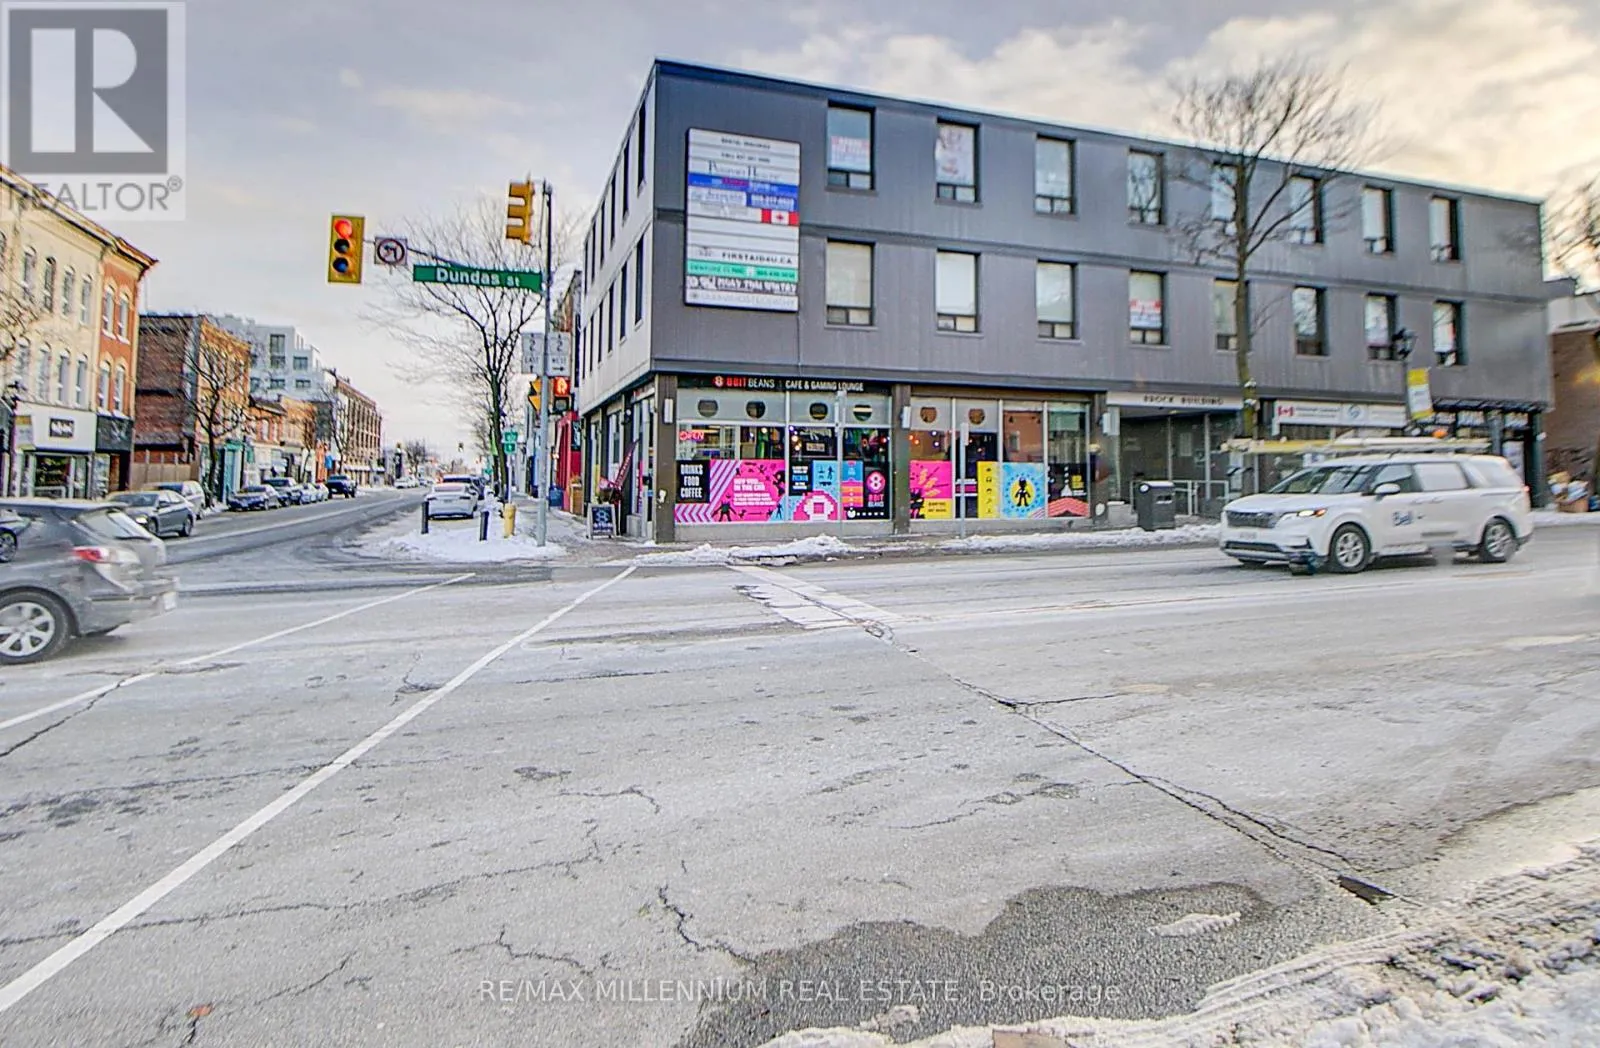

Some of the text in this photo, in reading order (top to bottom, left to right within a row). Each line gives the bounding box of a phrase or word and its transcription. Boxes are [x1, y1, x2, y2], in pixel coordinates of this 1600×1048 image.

[436, 267, 501, 286] Dundas
[748, 378, 775, 389] BEANS
[811, 381, 837, 391] GAMING
[838, 382, 864, 392] LOUNGE
[680, 431, 704, 441] OPEN
[681, 464, 703, 475] DRINKS
[684, 476, 699, 486] FOOD
[681, 487, 702, 498] COFFEE
